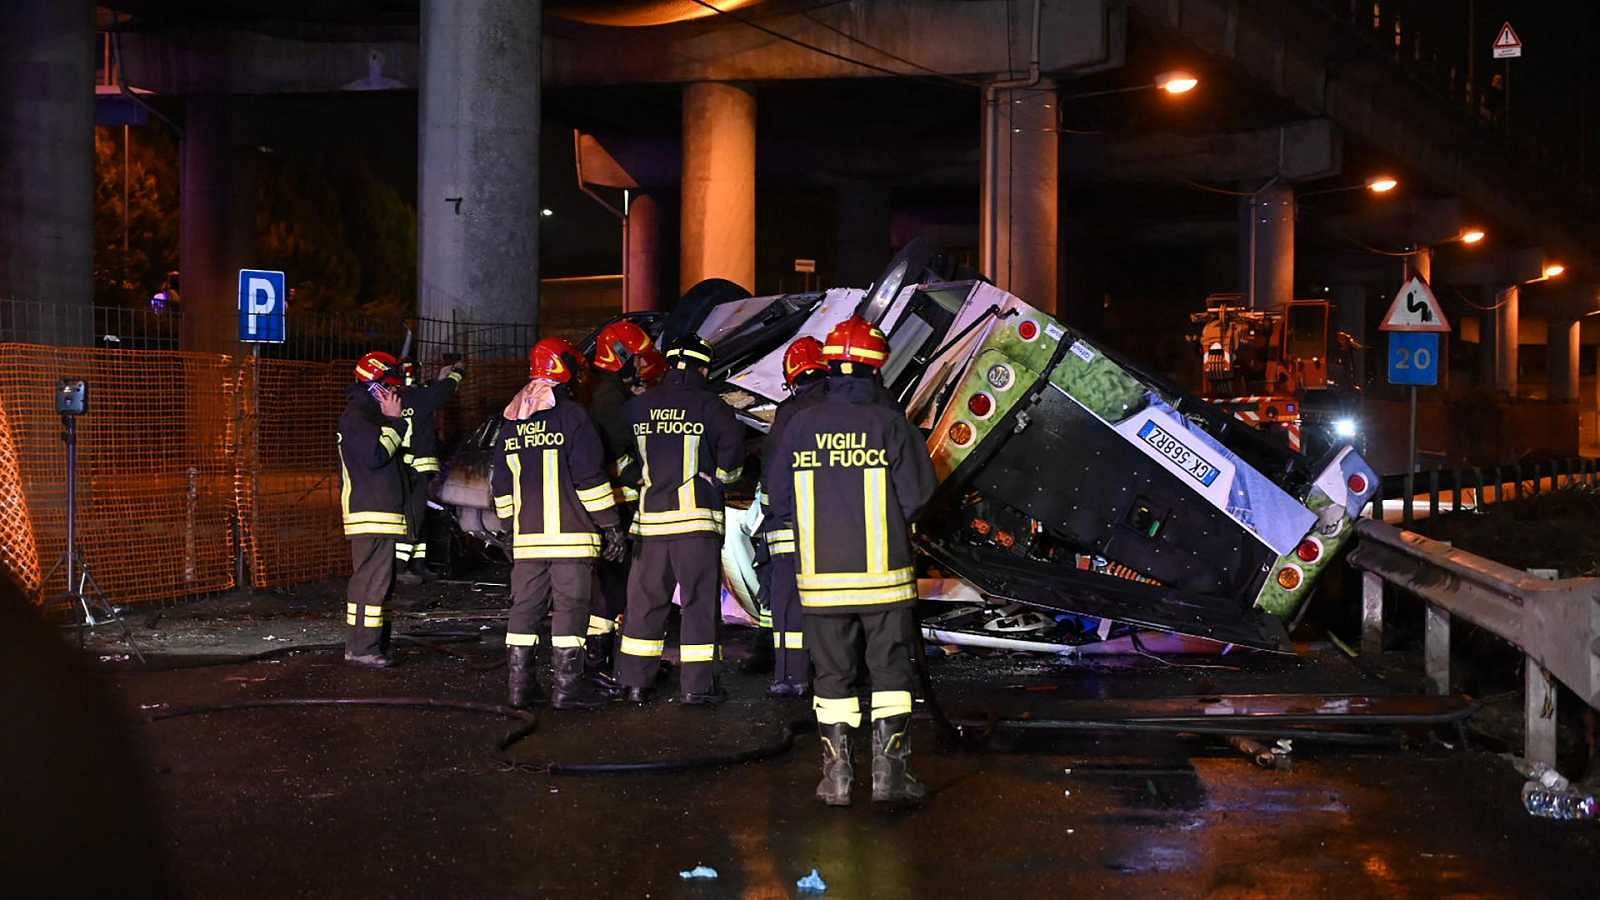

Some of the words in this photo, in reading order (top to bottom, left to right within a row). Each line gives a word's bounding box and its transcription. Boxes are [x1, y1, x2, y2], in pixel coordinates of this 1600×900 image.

[248, 277, 275, 334] P
[1395, 347, 1431, 370] 20
[650, 408, 686, 420] VIGILI
[516, 420, 546, 436] VIGILI
[633, 422, 652, 435] DEL
[657, 421, 704, 435] FUOCO
[524, 432, 564, 448] FUOCO
[815, 432, 867, 449] VIGILI
[1148, 429, 1190, 464] 568RZ
[1189, 458, 1208, 478] GK
